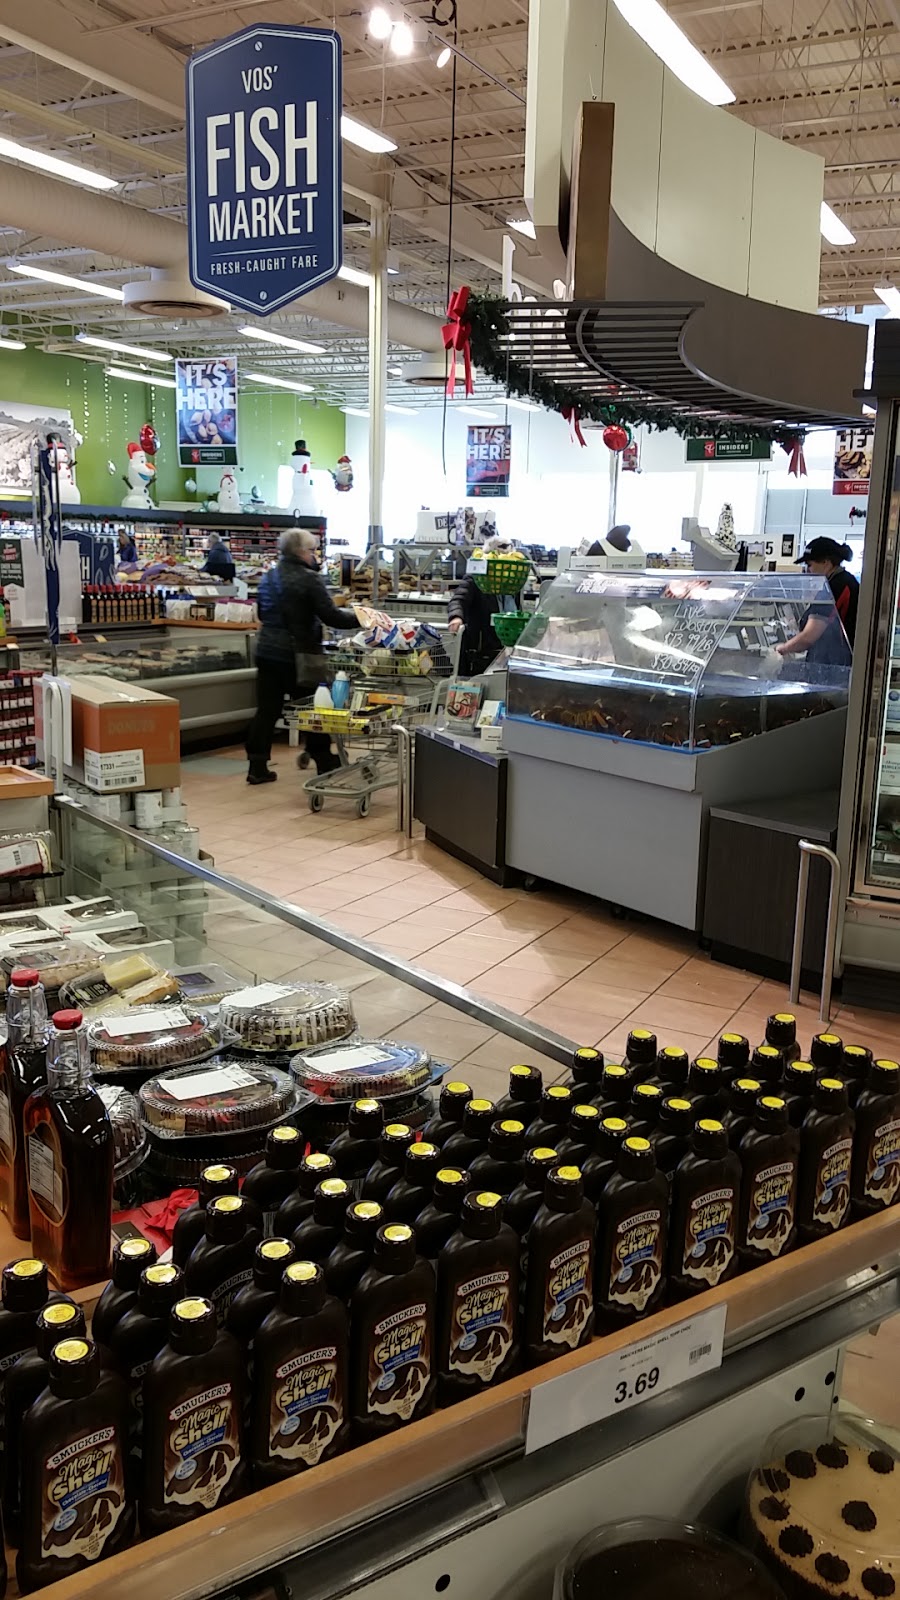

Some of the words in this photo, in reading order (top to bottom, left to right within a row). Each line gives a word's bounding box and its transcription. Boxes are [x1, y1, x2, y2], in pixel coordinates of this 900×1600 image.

[241, 65, 278, 94] VOS'
[206, 100, 318, 197] FISH
[208, 191, 318, 243] MARKET
[210, 255, 287, 276] FRESH-CAUGHT
[291, 254, 318, 269] FARE
[186, 363, 228, 387] IT'S
[177, 387, 237, 411] HERE
[473, 427, 506, 444] IT'S
[466, 444, 511, 460] HERE
[765, 541, 774, 555] 5
[757, 1181, 790, 1206] Shell
[761, 1175, 787, 1192] Magic
[693, 1209, 729, 1235] Shell
[697, 1203, 726, 1221] Magic
[619, 1229, 657, 1259] Shell
[624, 1224, 652, 1244] Magic
[552, 1261, 588, 1295] Shell
[557, 1258, 584, 1280] Magic
[214, 1268, 253, 1297] SMUCKER
[462, 1272, 507, 1294] SMUCKER'S
[460, 1293, 505, 1325] Shell
[466, 1287, 500, 1310] Magic
[379, 1304, 424, 1332] SMUCKER'S
[378, 1326, 424, 1364] Shell
[382, 1322, 419, 1348] Magic
[281, 1348, 334, 1375] SMUCKER'S
[280, 1369, 332, 1408] Shell
[286, 1366, 325, 1391] Magic
[614, 1366, 660, 1404] 3.69
[174, 1385, 229, 1418] SMUCKER'S
[175, 1407, 228, 1451] Shell
[179, 1405, 221, 1431] Magic
[52, 1429, 112, 1466] SMUCKER'S
[53, 1451, 111, 1500] Shell
[59, 1449, 104, 1481] Magic
